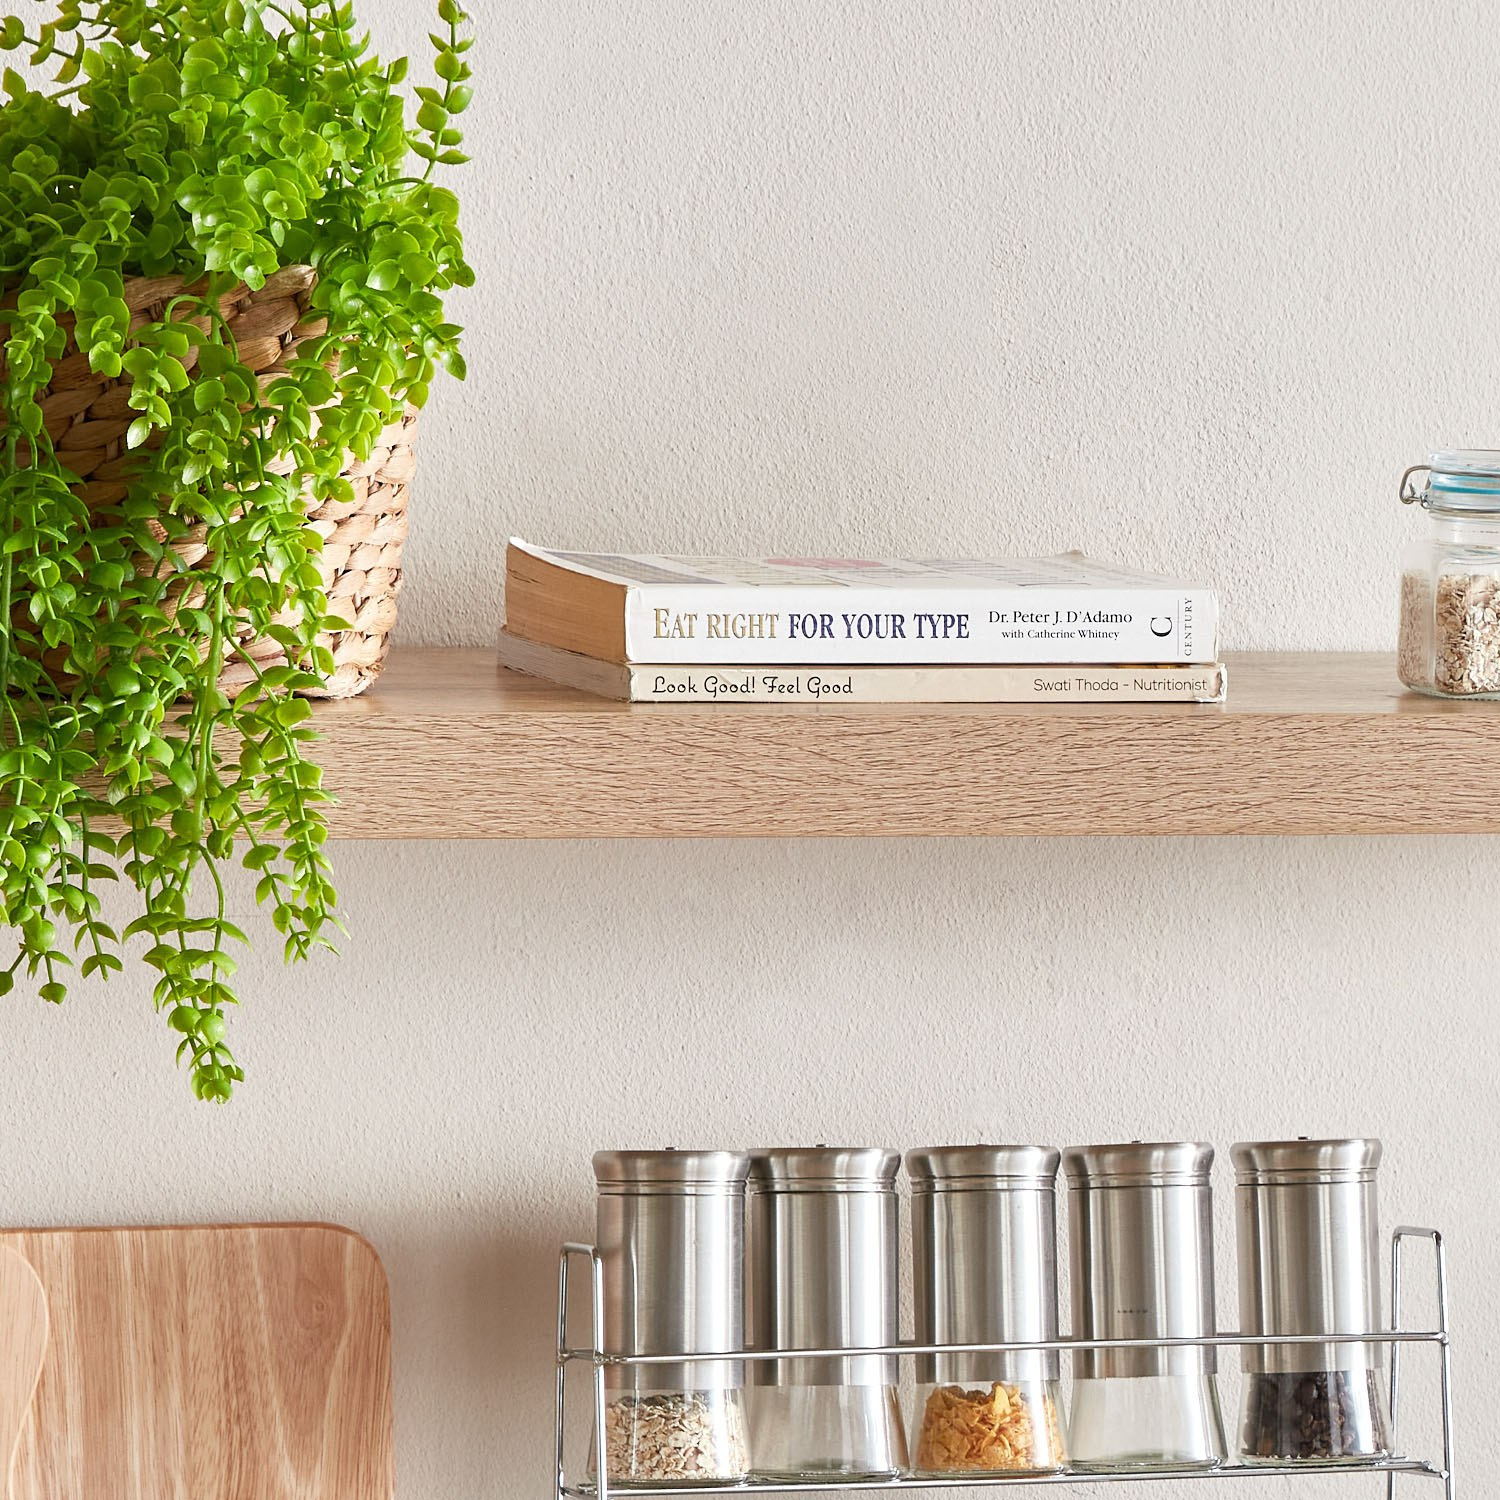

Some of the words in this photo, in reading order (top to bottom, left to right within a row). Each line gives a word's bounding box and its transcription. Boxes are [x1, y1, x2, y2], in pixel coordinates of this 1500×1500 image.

[653, 608, 698, 639] EAT
[706, 612, 779, 639] RIGHT
[788, 613, 835, 639] FOR
[842, 613, 907, 639] YOUR
[913, 613, 970, 639] TYPE
[988, 610, 1008, 624] Dr.
[1013, 610, 1050, 624] Peter
[1052, 610, 1063, 626] J.
[1067, 610, 1133, 624] D'Adamo
[1184, 597, 1193, 656] CENTURY
[1001, 629, 1024, 639] with
[1027, 629, 1076, 639] Catherine
[1077, 629, 1120, 641] Whitney
[652, 675, 698, 694] Look
[704, 675, 755, 698] Good!
[762, 675, 801, 694] Feel
[807, 675, 853, 698] Good
[1033, 678, 1072, 692] Swati
[1075, 678, 1119, 692] Thoda
[1133, 678, 1208, 692] Nutritionist
